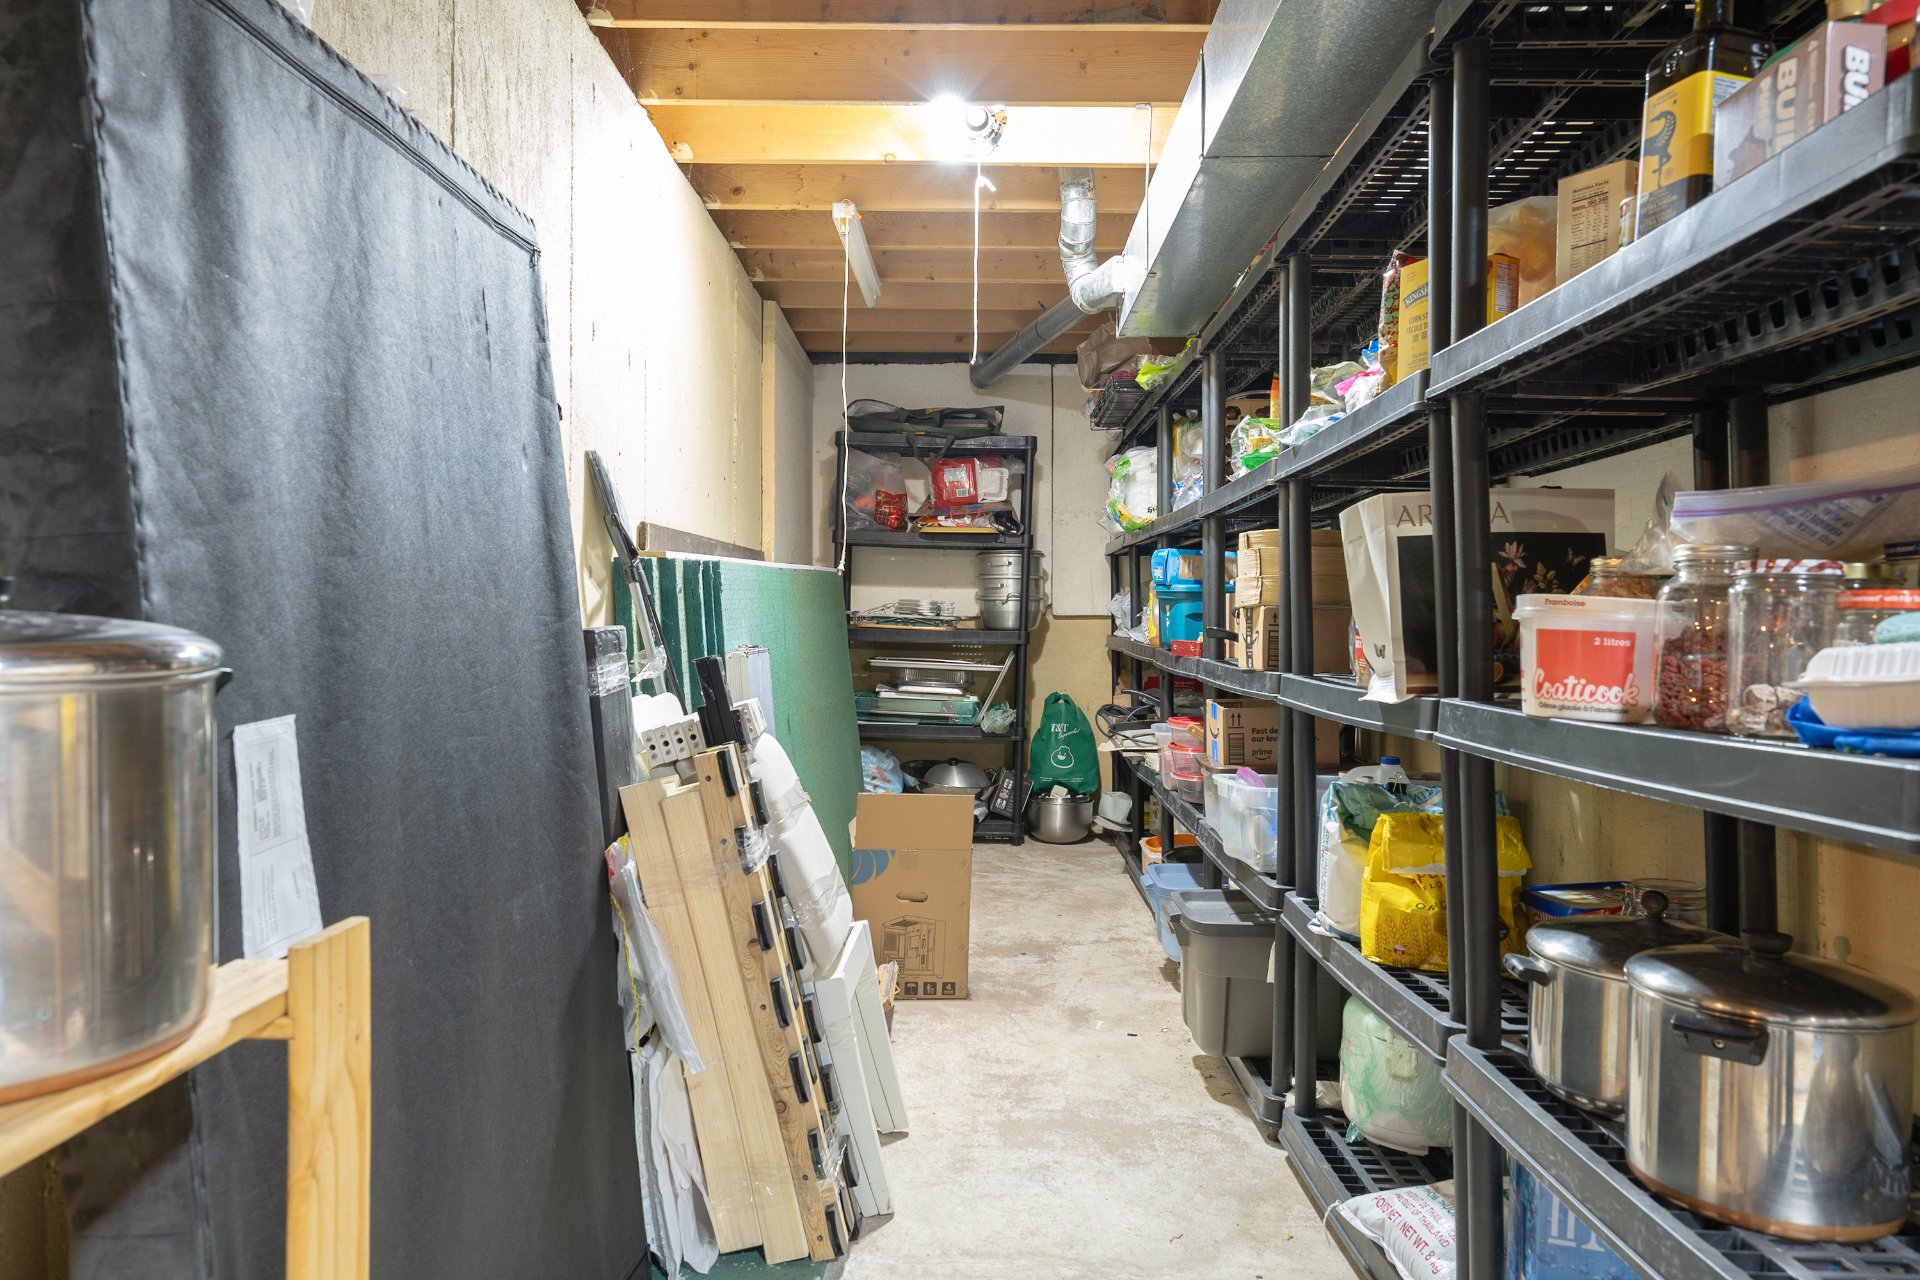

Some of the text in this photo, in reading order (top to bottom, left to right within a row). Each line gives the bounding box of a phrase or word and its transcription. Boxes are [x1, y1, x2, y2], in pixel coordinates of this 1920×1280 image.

[1408, 314, 1422, 325] CORN
[1594, 637, 1631, 647] 2 litres
[1533, 667, 1640, 706] Coaticook
[1051, 723, 1070, 733] T&T
[1251, 727, 1278, 736] Fast de
[1266, 735, 1278, 743] lov
[1251, 748, 1273, 758] prime
[1423, 881, 1443, 893] FLO
[945, 983, 952, 991] 4
[1419, 1198, 1429, 1209] DE
[1411, 1207, 1422, 1217] OF
[1419, 1215, 1450, 1248] THAILAND
[1400, 1221, 1417, 1241] NET
[1413, 1234, 1429, 1256] WT.
[1424, 1250, 1436, 1262] 8
